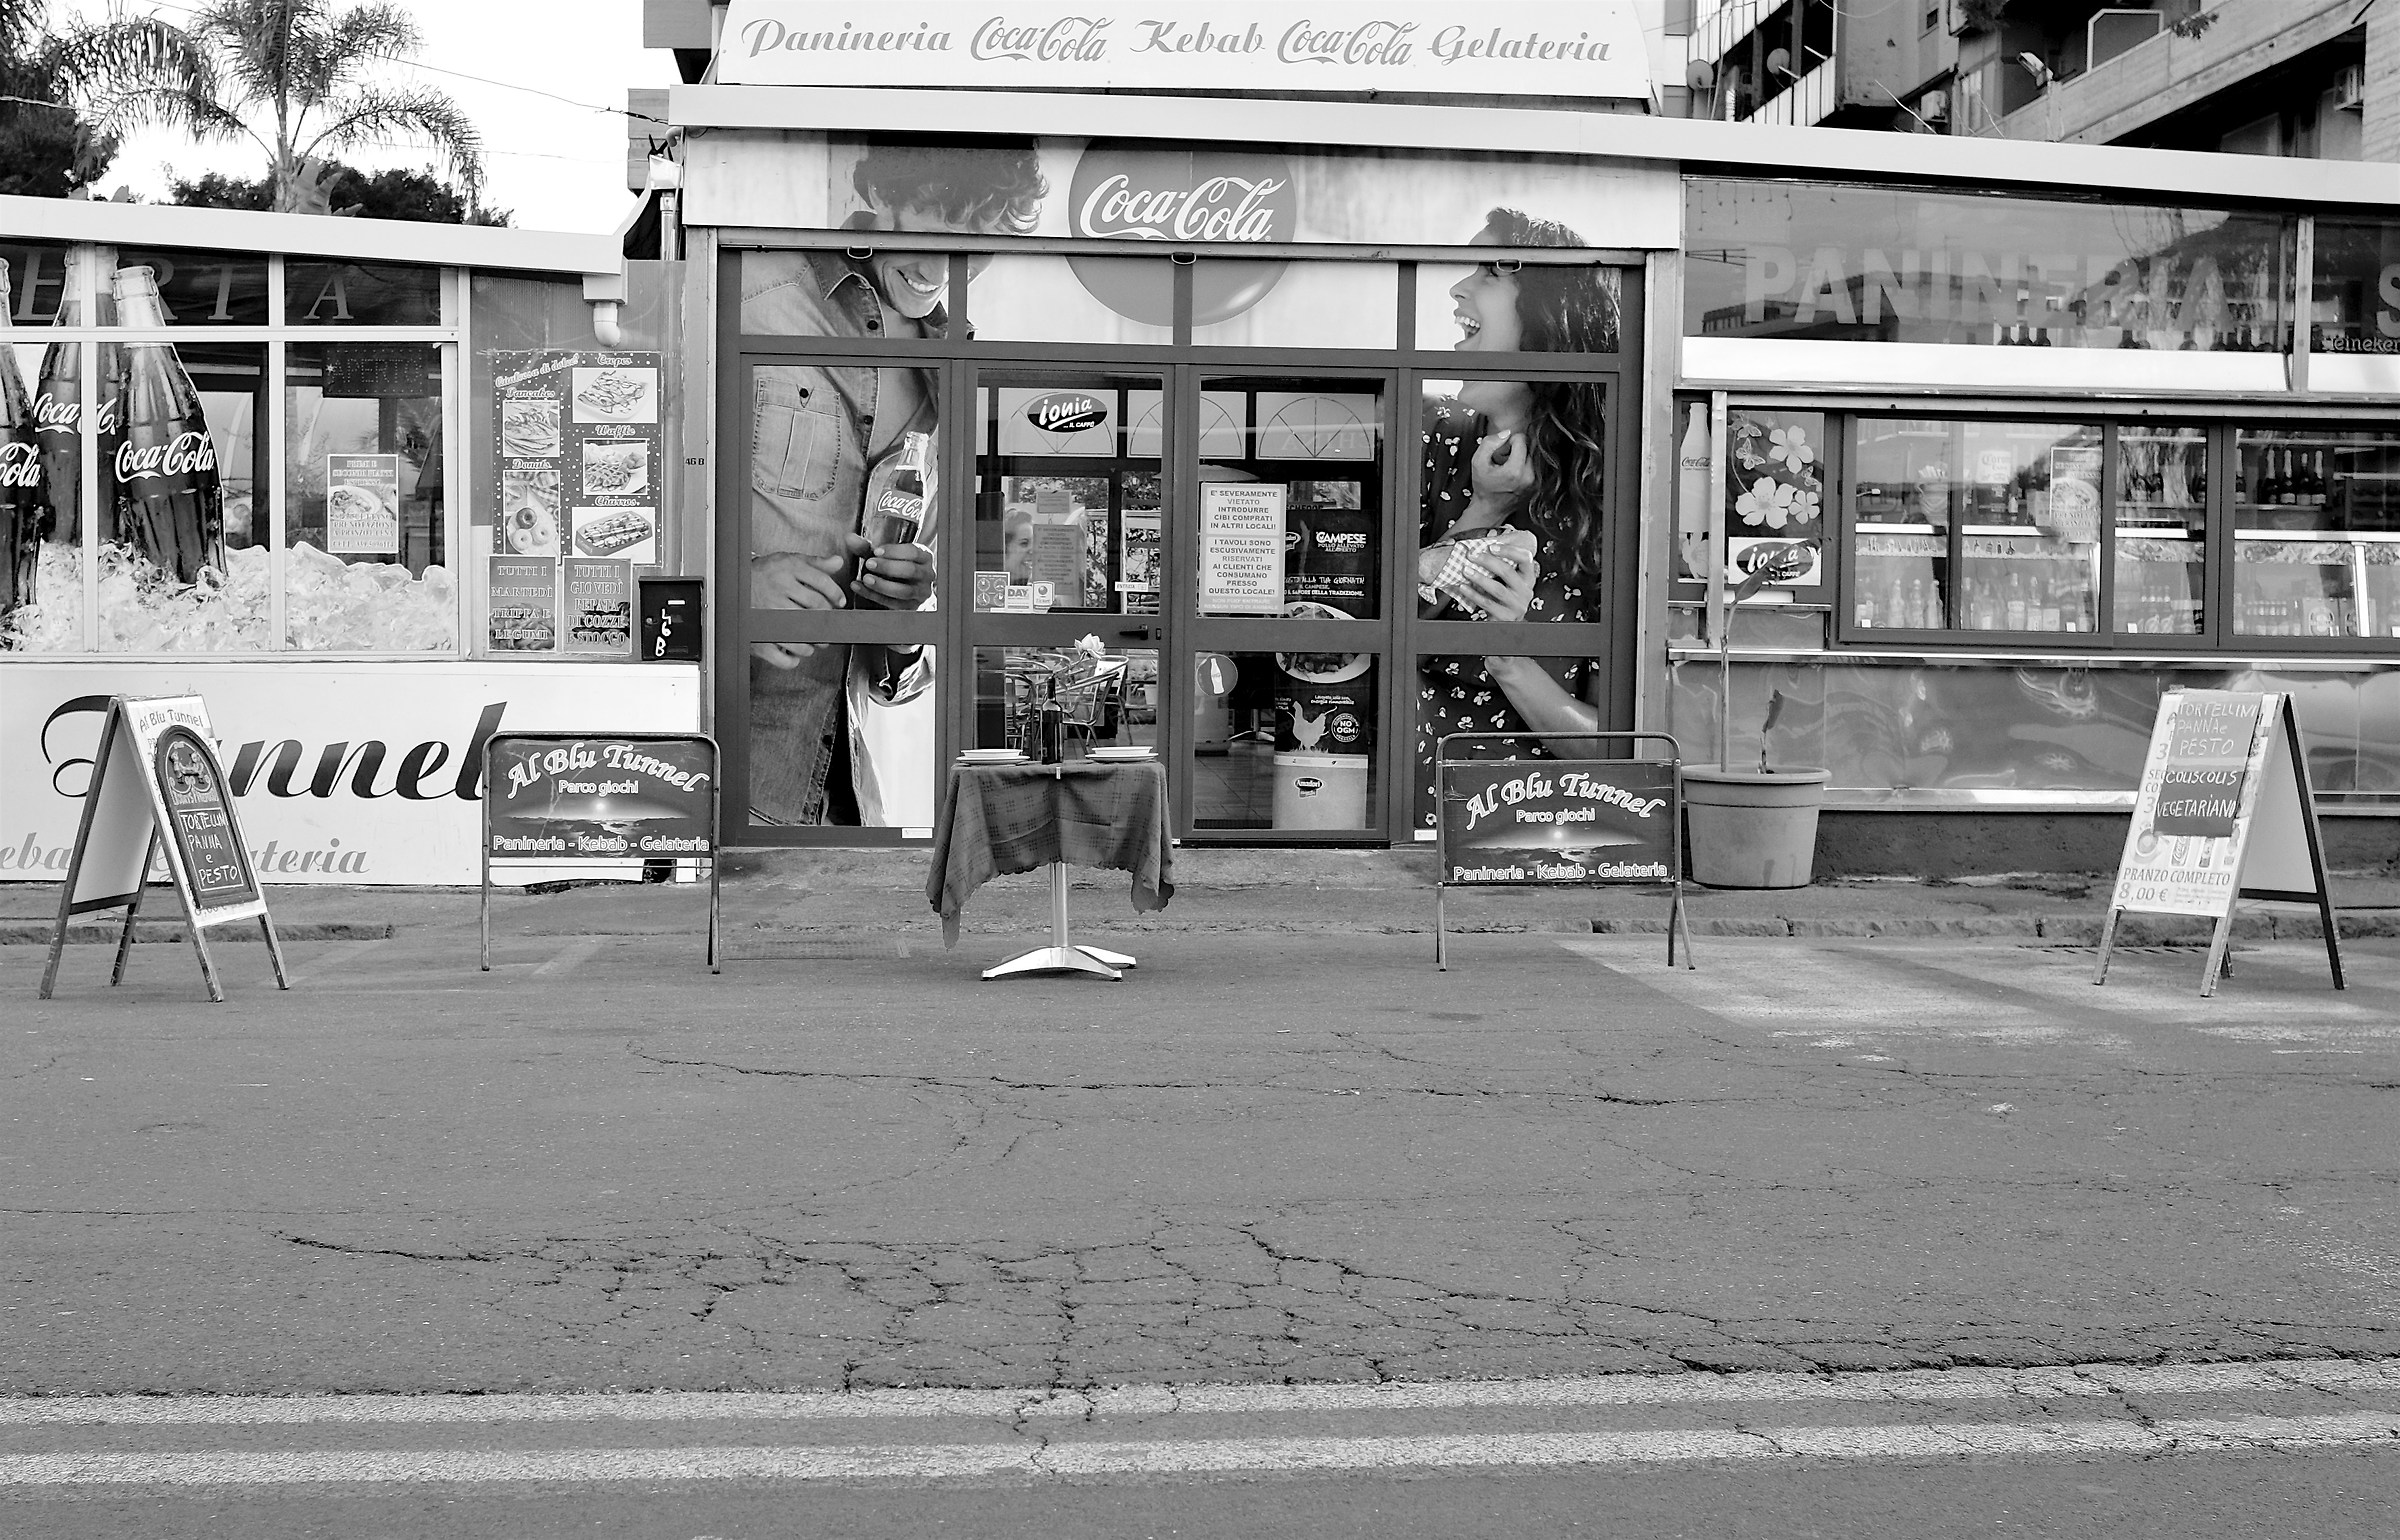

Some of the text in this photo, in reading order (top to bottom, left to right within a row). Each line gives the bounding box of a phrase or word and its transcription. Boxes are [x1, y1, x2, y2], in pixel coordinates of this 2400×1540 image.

[741, 16, 1613, 66] Panineria Coca-Cola Kebab Coca-Cola Gelateria
[1080, 174, 1287, 242] Coca-Cola
[1742, 242, 2232, 332] PANINERIA
[597, 355, 632, 366] Crepes
[505, 387, 555, 398] Pancakes
[1039, 397, 1093, 426] ionia
[595, 425, 635, 438] Waffle
[115, 431, 215, 483] Coca-Cola
[1316, 531, 1367, 544] CAMPESE
[498, 565, 538, 576] TUTTI
[574, 564, 611, 578] TUTTI
[1008, 588, 1028, 597] DAY
[493, 608, 540, 619] TRIPPA
[574, 598, 620, 611] PEPATA
[567, 614, 626, 628] DI COZZE
[494, 629, 549, 640] LEGUMI
[149, 711, 166, 726] Blu
[167, 709, 204, 727] Tunnel
[2178, 702, 2258, 718] TORTELLINI
[41, 694, 508, 801] Tnnel
[2179, 738, 2235, 756] PESTO
[543, 742, 599, 775] Blu
[603, 744, 711, 793] Tunnel
[2165, 770, 2238, 786] COUSCOUS
[558, 779, 639, 797] Parco giochi
[1500, 771, 1553, 806] Blu
[1559, 772, 1667, 818] Tunnel
[1516, 807, 1596, 825] Parco giochi
[187, 834, 223, 852] PANNA
[493, 835, 566, 851] Panineria
[578, 835, 628, 851] Kebab
[639, 835, 709, 851] Gelateria
[205, 854, 214, 863] e
[199, 864, 238, 887] PESTO
[1453, 865, 1525, 881] Panineria
[1536, 863, 1586, 879] Kebab
[1598, 861, 1668, 878] Gelateria
[2123, 867, 2231, 886] PRANZO COMPLETO
[2118, 882, 2155, 903] 8,00
[2159, 888, 2169, 902] €
